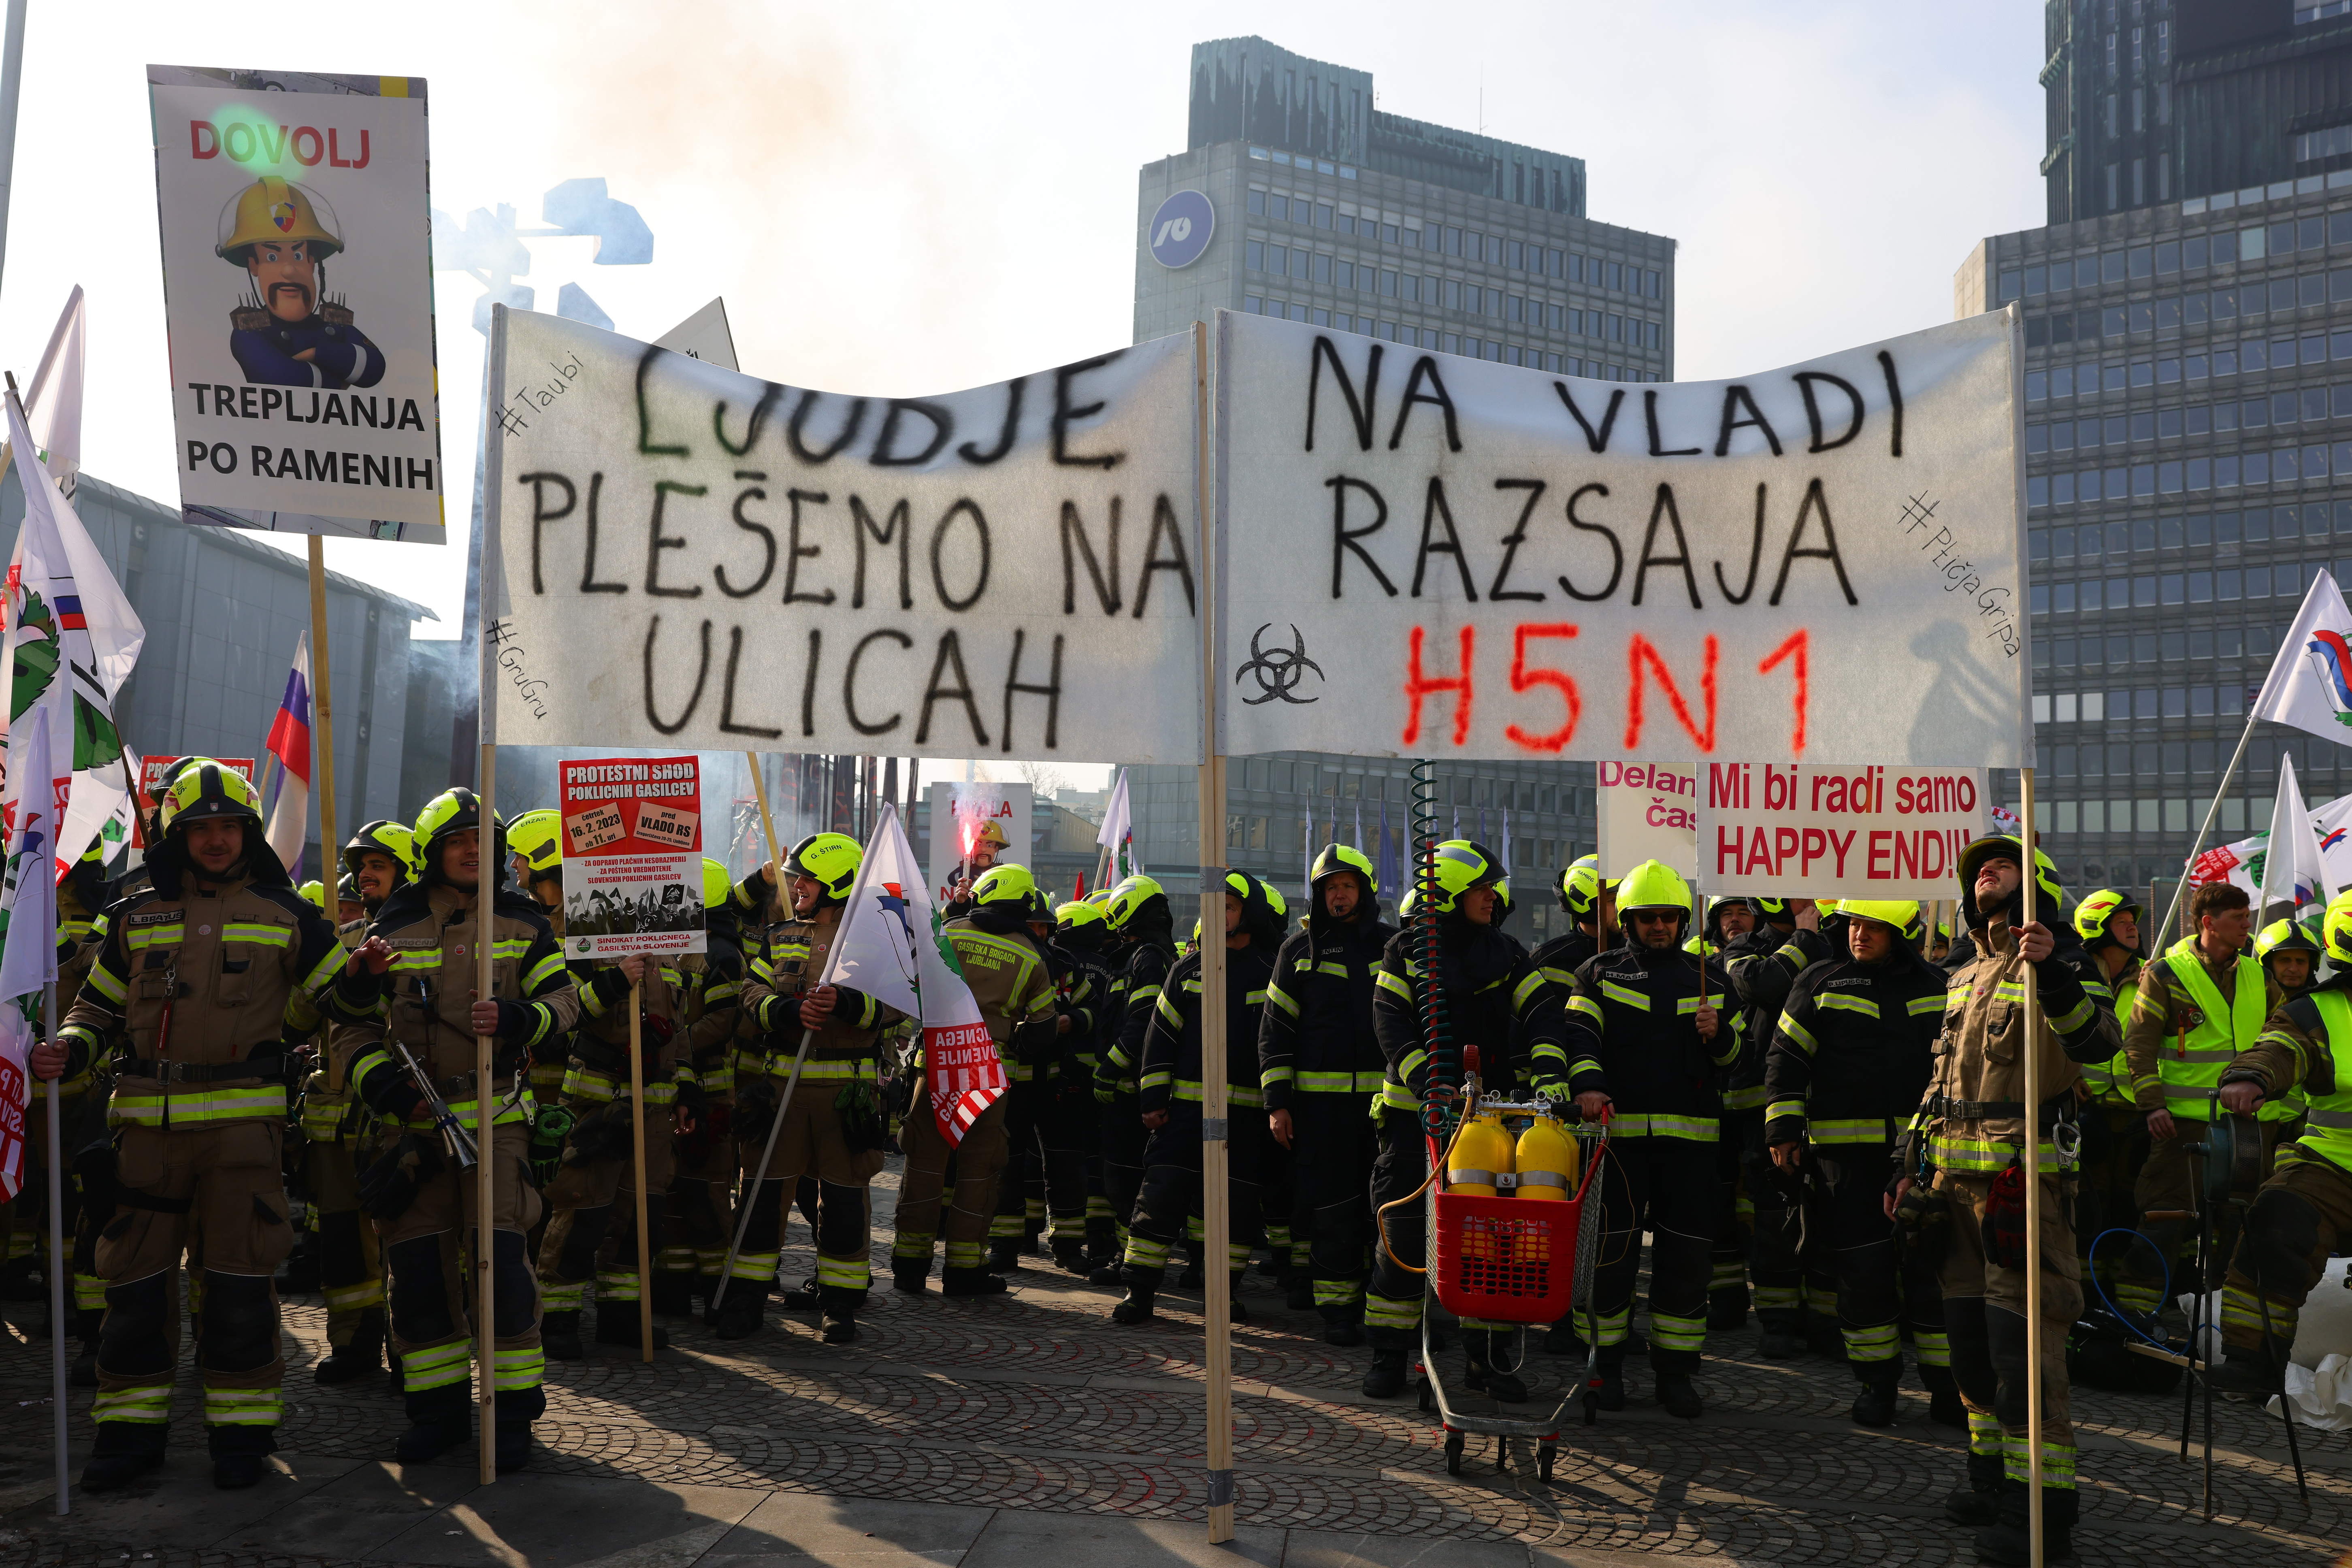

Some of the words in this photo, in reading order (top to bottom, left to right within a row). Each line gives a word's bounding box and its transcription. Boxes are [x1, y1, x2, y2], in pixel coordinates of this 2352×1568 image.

[190, 120, 370, 169] DOVOLJ
[495, 351, 583, 437] #Taubi
[1306, 336, 1463, 452] NA
[1554, 351, 1904, 458] VLADI
[189, 383, 425, 431] TREPLJANJA
[187, 440, 237, 474] PO
[251, 445, 433, 490] RAMENIH
[519, 471, 991, 612] PLEŠEMO
[1060, 492, 1195, 619] NA
[1325, 475, 1859, 609] RAZSAJA
[486, 619, 548, 720] #GruGru
[644, 614, 1065, 752] ULICAH
[1403, 624, 1809, 758] H5N1
[567, 765, 648, 783] PROTESTNI
[652, 763, 694, 780] SHOD
[568, 784, 633, 800] POKLICNIH
[636, 782, 694, 797] GASILCEV
[1709, 763, 1750, 808] Mi
[1764, 764, 1798, 811] bi
[1812, 766, 1883, 813] radi
[1896, 776, 1976, 812] samo
[520, 817, 546, 827] ERZAR
[570, 827, 586, 838] 16.
[586, 823, 596, 833] 2.
[596, 814, 620, 830] 2023
[582, 809, 604, 821] četrtek
[661, 811, 675, 820] pred
[641, 816, 675, 833] VLADO
[676, 825, 691, 837] RS
[585, 840, 593, 848] ob
[592, 833, 606, 845] 11.
[607, 834, 616, 842] uri
[636, 831, 660, 841] Gregorčičeva
[673, 838, 690, 846] Ljubljana
[819, 844, 842, 854] ŠTIRN
[620, 857, 643, 865] PLAČNIH
[644, 856, 686, 864] NESORAZMERIJ
[1717, 826, 1857, 878] HAPPY
[131, 910, 183, 923] L.BRATUŠ
[957, 942, 987, 955] GASILSKA
[989, 948, 1016, 965] BRIGADA
[966, 954, 1001, 971] LJUBLJANA
[1086, 963, 1110, 980] BRIGADA
[1828, 978, 1870, 986] P.LIPUŠČEK
